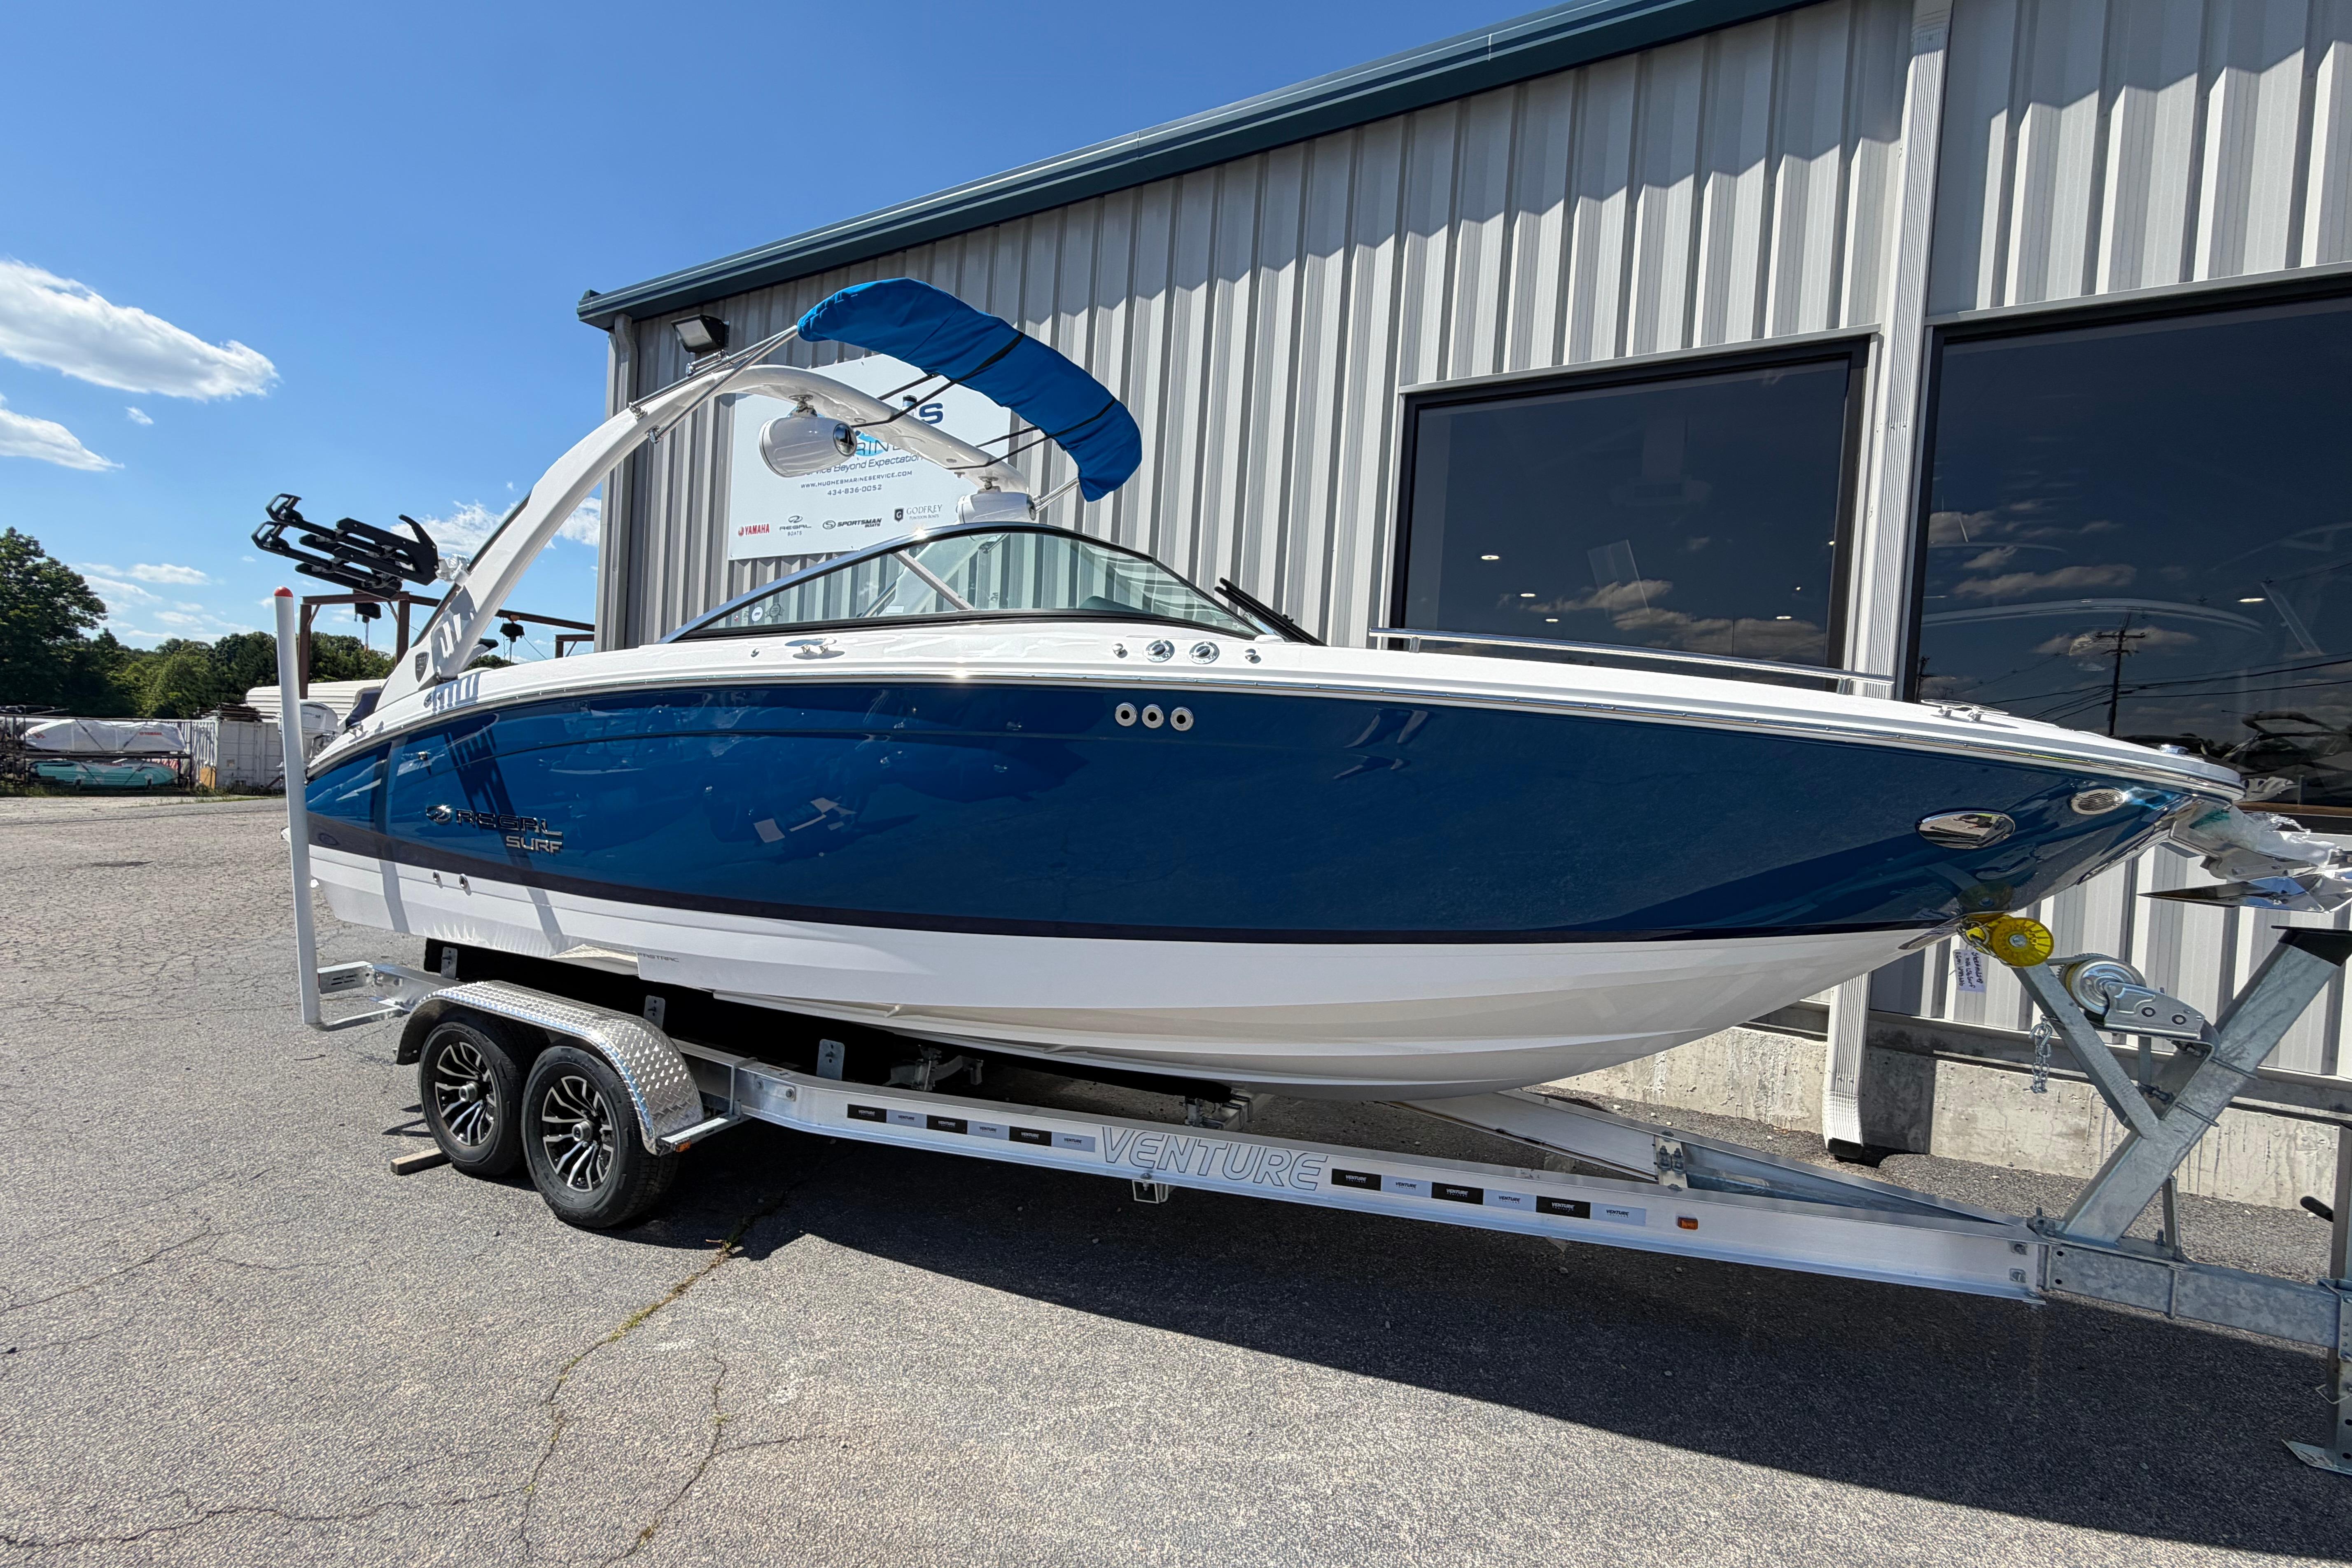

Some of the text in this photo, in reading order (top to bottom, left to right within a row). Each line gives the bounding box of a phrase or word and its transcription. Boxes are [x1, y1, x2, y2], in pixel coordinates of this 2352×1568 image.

[834, 460, 867, 473] Beyond
[827, 484, 882, 495] 434-836-0052
[906, 504, 942, 514] GODFREY
[837, 518, 882, 527] SPORTSMAN
[745, 523, 770, 535] YAMAHA
[456, 808, 563, 836] REGAL
[506, 835, 562, 853] SURF
[1102, 1126, 1329, 1191] VENTURE
